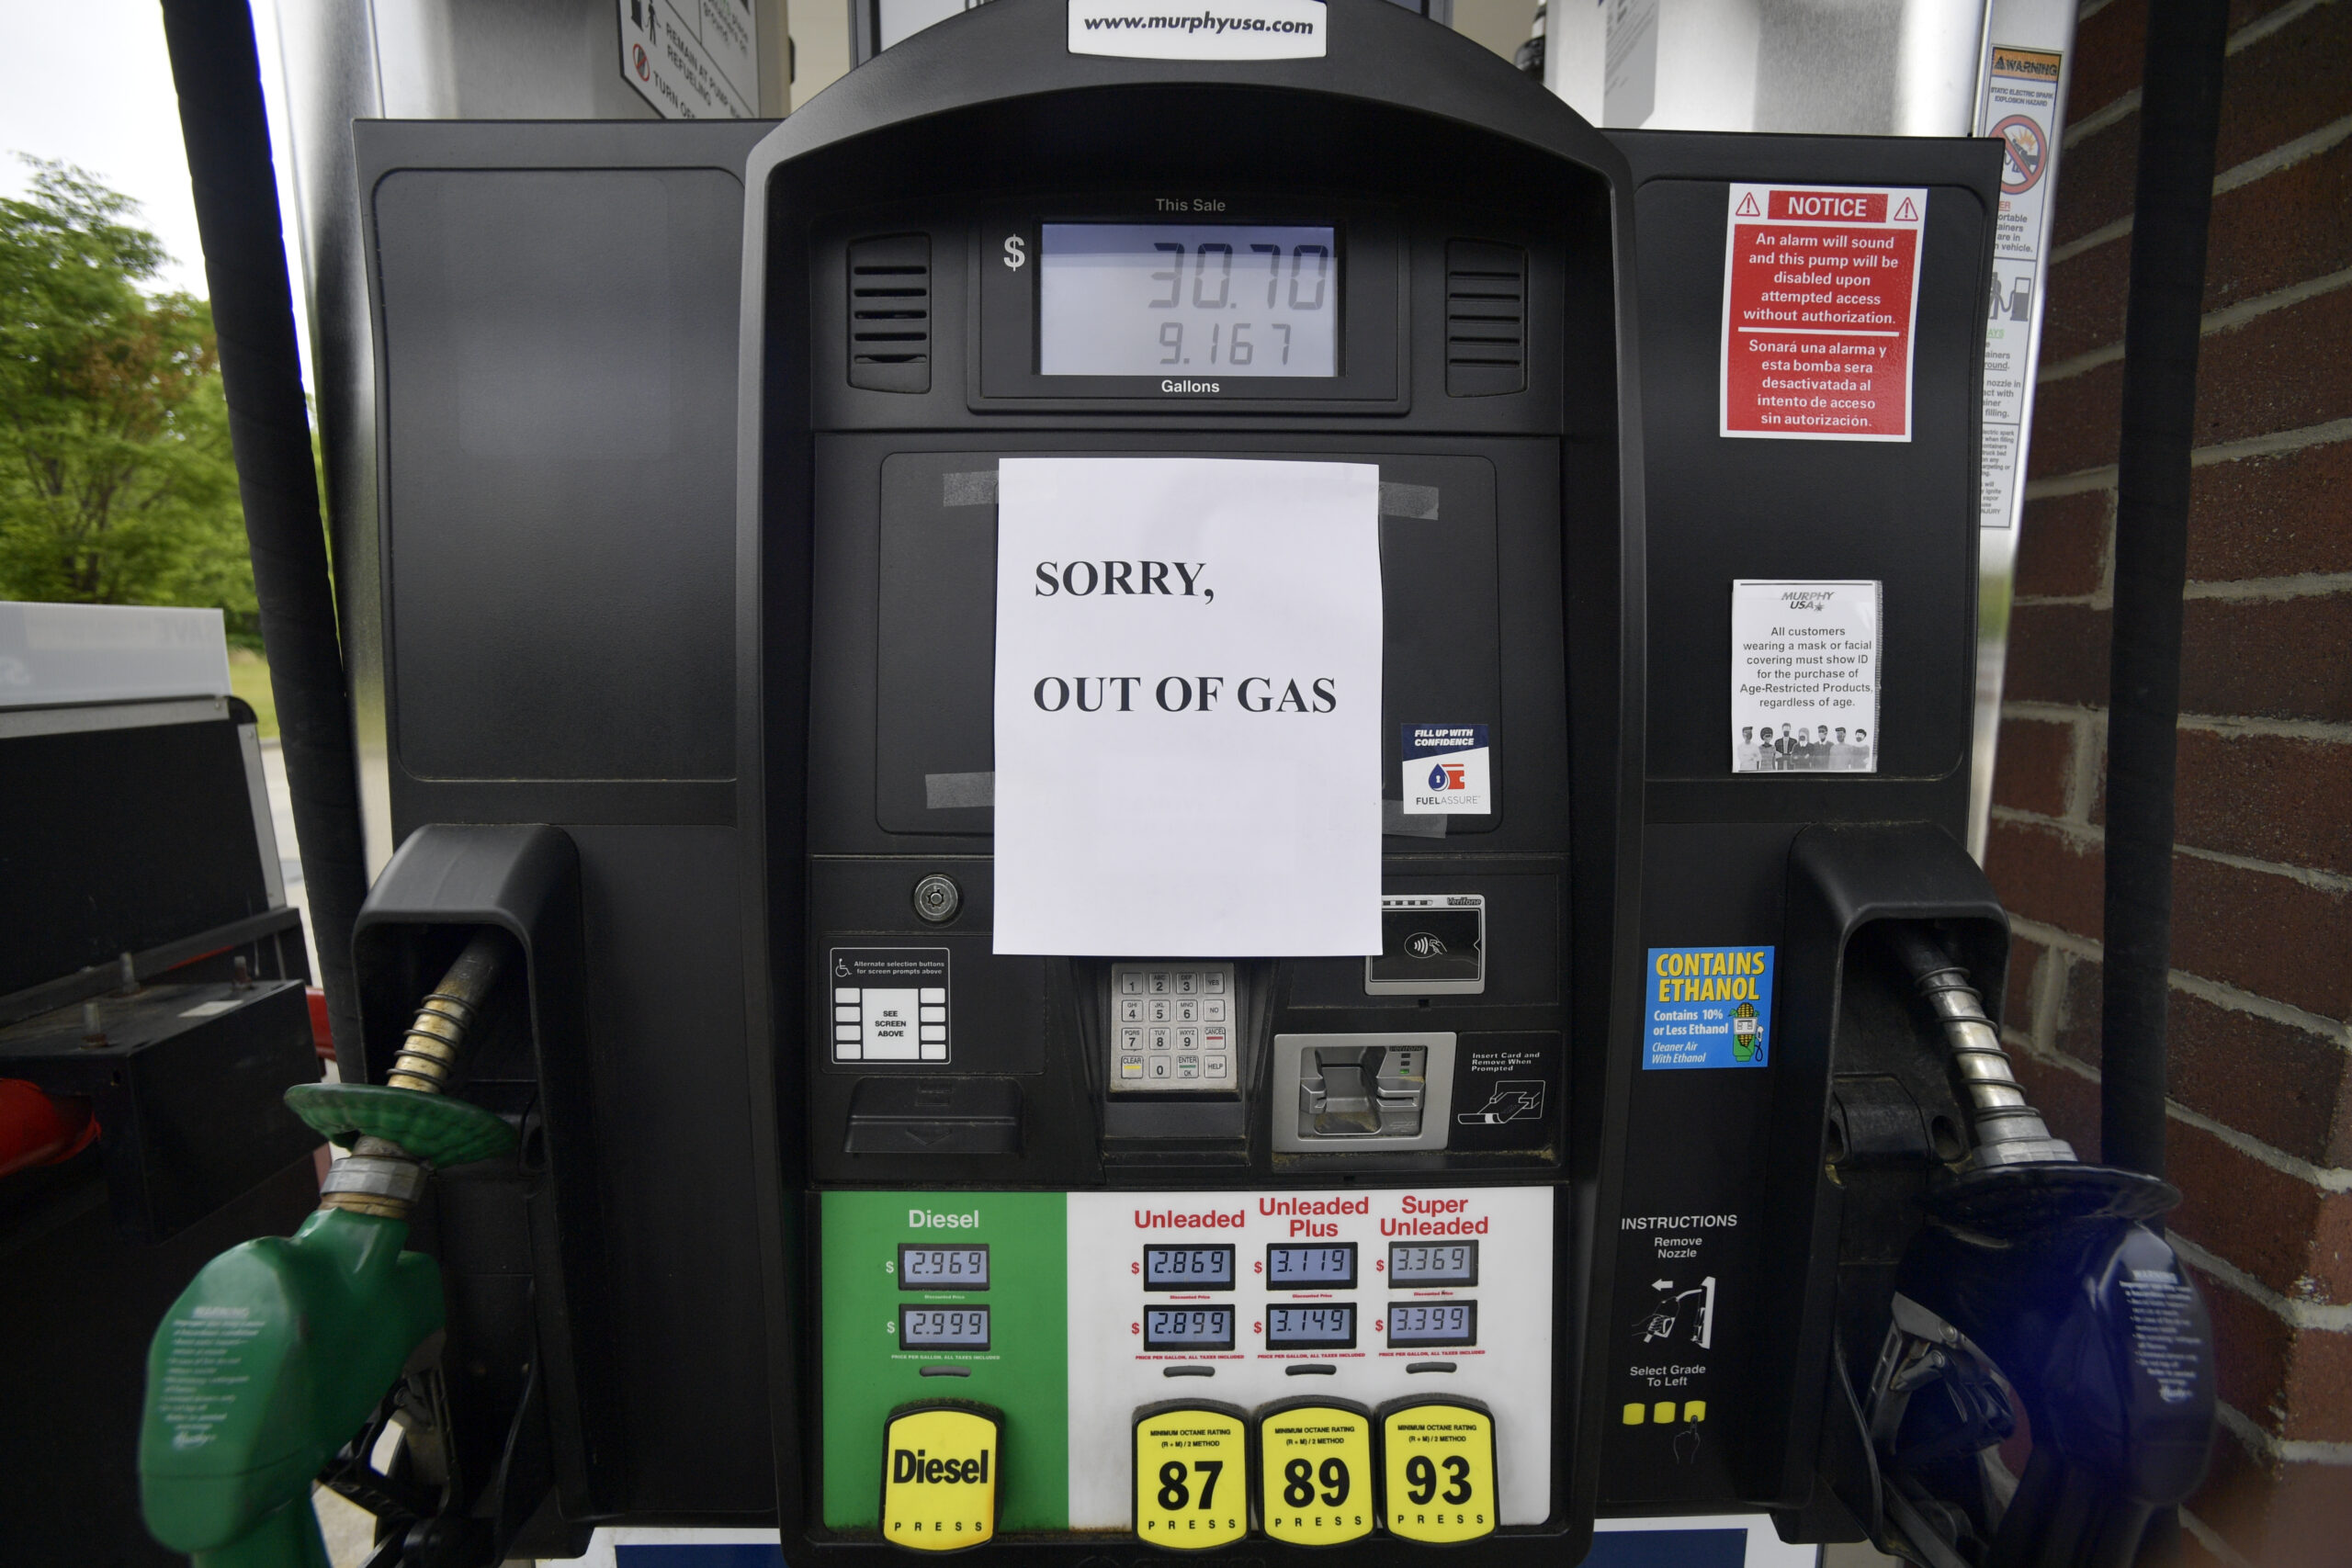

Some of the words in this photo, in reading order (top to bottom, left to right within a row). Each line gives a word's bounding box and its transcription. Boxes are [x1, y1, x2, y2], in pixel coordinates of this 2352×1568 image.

[1084, 12, 1314, 34] www.murphyusa.com
[2007, 59, 2057, 75] WARNING
[653, 71, 678, 108] TURN
[1995, 96, 2024, 104] EXPLOSION
[1156, 198, 1188, 211] This
[1193, 198, 1226, 211] Sale
[1788, 197, 1867, 217] NOTICE
[1757, 232, 1775, 246] An
[1780, 233, 1817, 246] alarm
[1823, 235, 1847, 247] will
[1852, 236, 1894, 249] sound
[2002, 243, 2032, 253] vehicle.
[1749, 253, 1774, 265] and
[1779, 254, 1804, 265] this
[1808, 255, 1849, 269] pump
[1853, 255, 1877, 267] will
[1882, 255, 1898, 268] be
[1003, 234, 1025, 271] $
[1148, 243, 1328, 310] 30.70
[1774, 272, 1831, 285] disabled
[1836, 276, 1871, 288] upon
[1761, 291, 1832, 305] attempted
[1836, 295, 1881, 305] access
[1744, 309, 1797, 321] without
[1802, 310, 1895, 323] authorization.
[1159, 322, 1291, 365] 9.167
[1749, 339, 1797, 353] Sonará
[1801, 344, 1826, 353] una
[1829, 343, 1874, 355] alarma
[1880, 346, 1887, 357] y
[1762, 360, 1790, 370] esta
[1793, 360, 1840, 372] bomba
[1845, 363, 1872, 373] sera
[1161, 380, 1220, 394] Gallons
[1762, 377, 1856, 390] desactivatada
[1860, 378, 1871, 390] al
[1758, 395, 1807, 407] intento
[1811, 396, 1826, 408] de
[1830, 399, 1875, 409] acceso
[1761, 413, 1781, 424] sin
[1784, 414, 1871, 426] autorización.
[1035, 560, 1214, 604] SORRY,
[1781, 592, 1835, 601] MURPHY
[1791, 601, 1815, 609] USA
[1771, 627, 1784, 636] All
[1789, 627, 1845, 636] customers
[1744, 642, 1785, 652] wearing
[1798, 641, 1826, 649] mask
[1845, 640, 1871, 649] facial
[1747, 656, 1792, 666] covering
[1796, 656, 1823, 664] must
[1826, 655, 1855, 663] show
[1858, 655, 1868, 663] ID
[1758, 670, 1771, 678] for
[1775, 670, 1791, 678] the
[1794, 670, 1845, 680] purchase
[1849, 669, 1859, 678] of
[1034, 676, 1141, 713] OUT
[1156, 676, 1224, 712] OF
[1238, 677, 1336, 713] GAS
[1740, 683, 1819, 694] Age-Restricted
[1823, 683, 1872, 694] Products,
[1759, 698, 1815, 707] regardless
[1819, 697, 1830, 706] of
[1833, 699, 1855, 708] age.
[1656, 952, 1765, 976] CONTAINS
[1130, 982, 1134, 991] 1
[1156, 982, 1163, 991] 2
[1183, 982, 1190, 991] 3
[1658, 977, 1759, 1002] ETHANOL
[1129, 1010, 1136, 1019] 4
[1157, 1010, 1163, 1019] 5
[1183, 1010, 1190, 1019] 6
[1654, 1010, 1698, 1021] Contains
[1702, 1010, 1723, 1020] 10%
[1654, 1027, 1664, 1035] or
[1667, 1025, 1687, 1035] Less
[1690, 1023, 1728, 1034] Ethanol
[1129, 1038, 1136, 1046] 7
[1157, 1038, 1163, 1047] 8
[1184, 1038, 1191, 1046] 9
[1652, 1042, 1683, 1052] Cleaner
[1652, 1054, 1671, 1064] With
[1673, 1053, 1706, 1063] Ethanol
[1157, 1066, 1163, 1075] 0
[1260, 1197, 1369, 1215] Unleaded
[1402, 1195, 1468, 1217] Super
[910, 1210, 978, 1227] Diesel
[1135, 1210, 1245, 1228] Unleaded
[1381, 1216, 1488, 1235] Unleaded
[1622, 1214, 1737, 1230] INSTRUCTIONS
[1290, 1219, 1338, 1237] Plus
[1655, 1236, 1702, 1247] Remove
[1277, 1250, 1344, 1272] 3.119
[1397, 1248, 1464, 1270] 3.369
[1657, 1248, 1697, 1258] Nozzle
[912, 1252, 981, 1274] 2.969
[1155, 1252, 1223, 1273] 2.869
[913, 1314, 981, 1335] 2.999
[1155, 1313, 1223, 1334] 2.899
[1276, 1310, 1343, 1332] 3.149
[1396, 1308, 1463, 1330] 3.399
[1630, 1367, 1666, 1375] Select
[1670, 1365, 1706, 1375] Grade
[1647, 1378, 1661, 1387] To
[1665, 1377, 1688, 1386] Left
[893, 1450, 989, 1483] Diesel
[1158, 1461, 1223, 1510] 87
[1283, 1458, 1350, 1508] 89
[1406, 1455, 1472, 1505] 93
